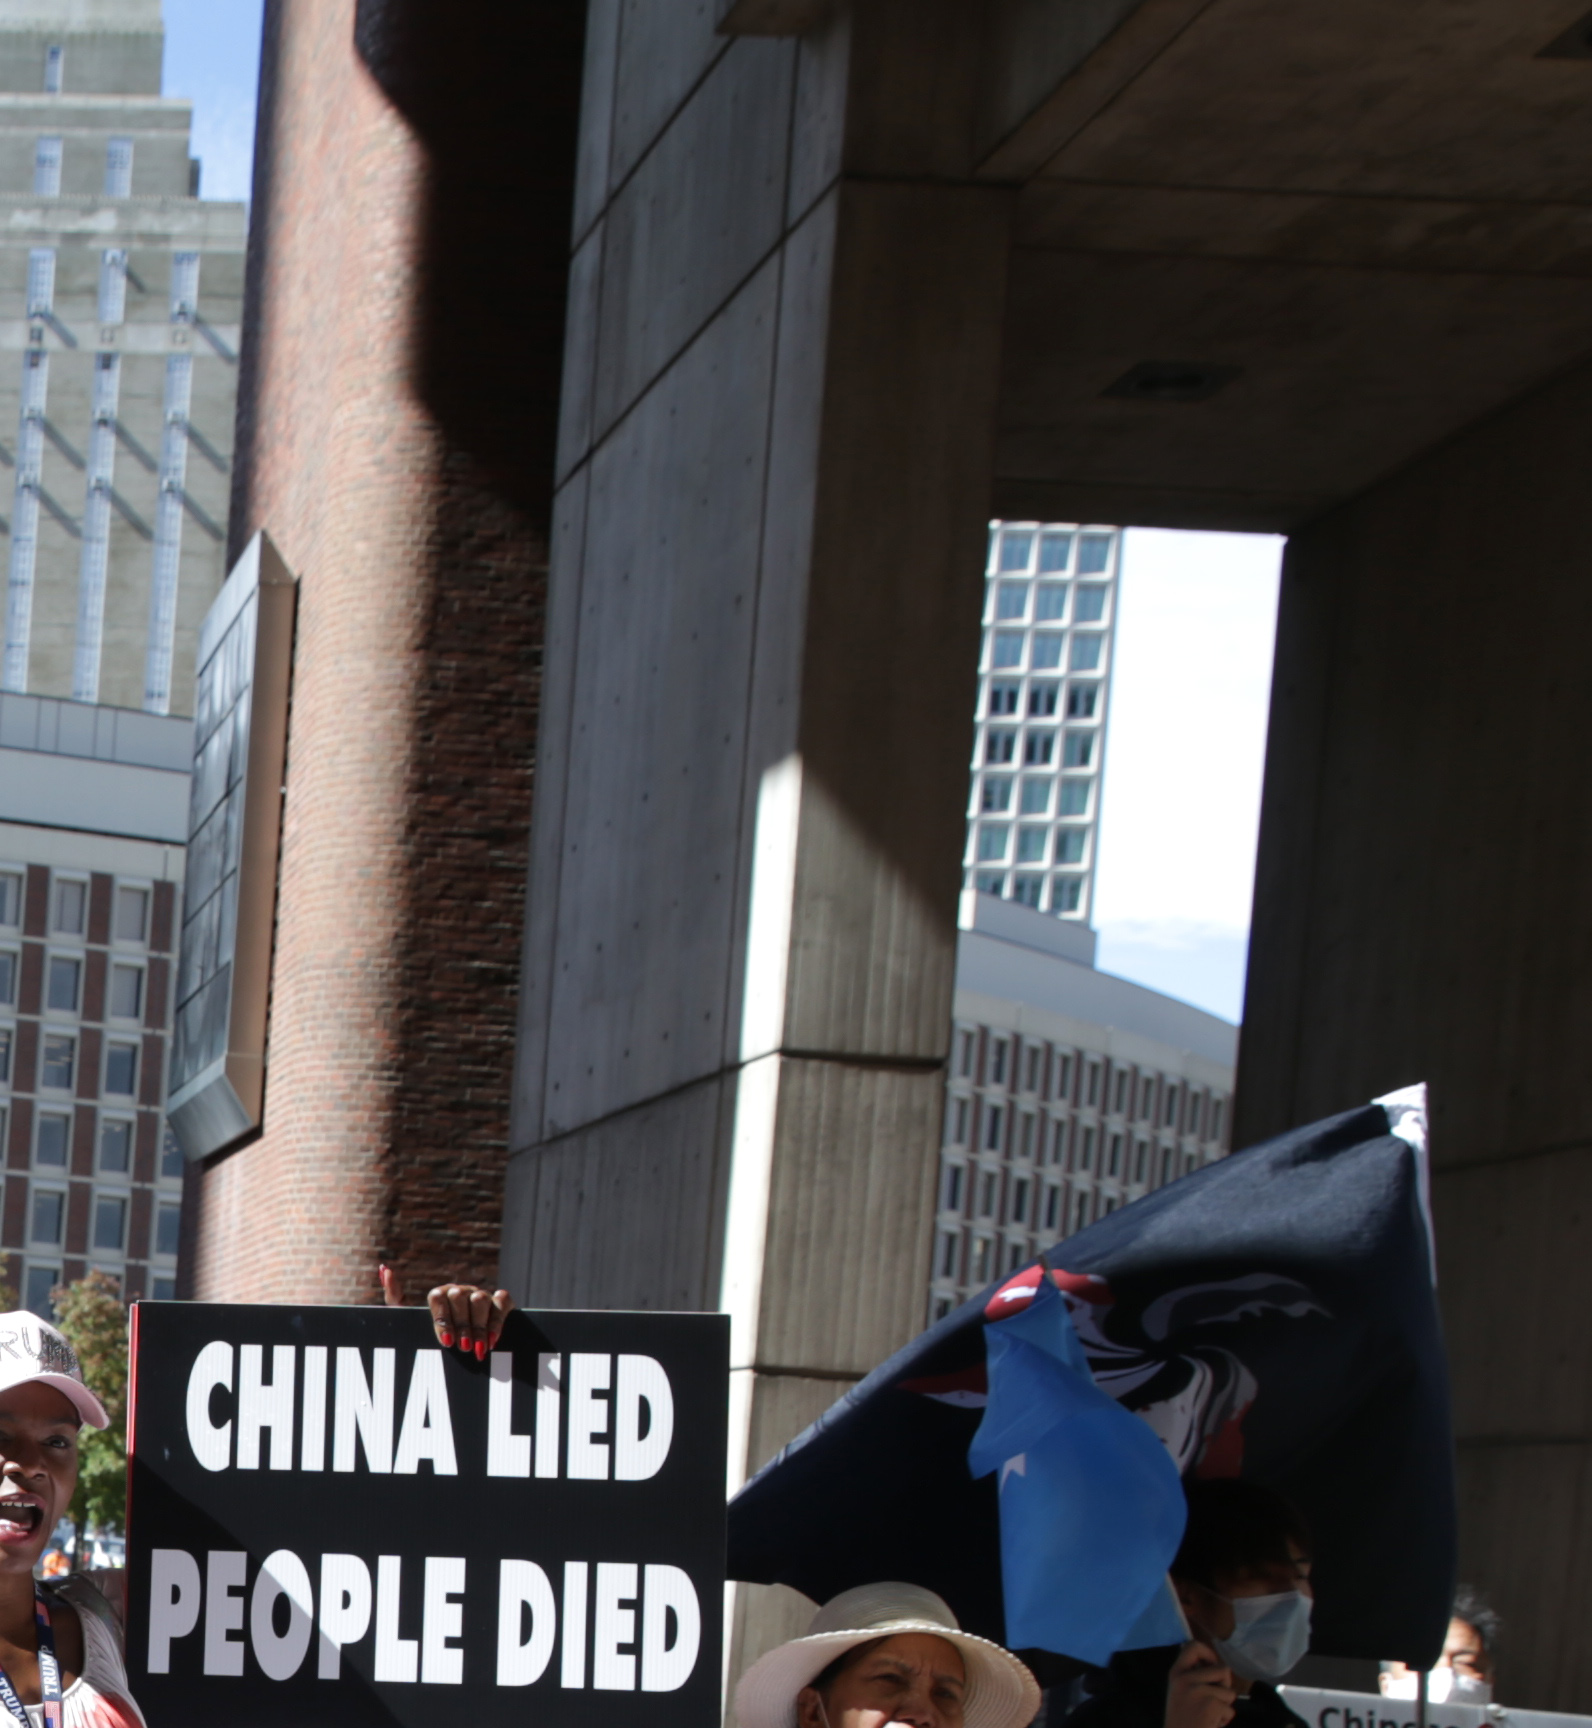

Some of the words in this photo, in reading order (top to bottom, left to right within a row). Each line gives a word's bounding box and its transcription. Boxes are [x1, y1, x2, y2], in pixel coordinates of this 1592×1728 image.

[185, 1339, 459, 1477] CHINA
[485, 1350, 675, 1482] LIED
[40, 1645, 59, 1695] TRUMP
[147, 1547, 467, 1685] PEOPLE
[495, 1558, 702, 1693] DIED
